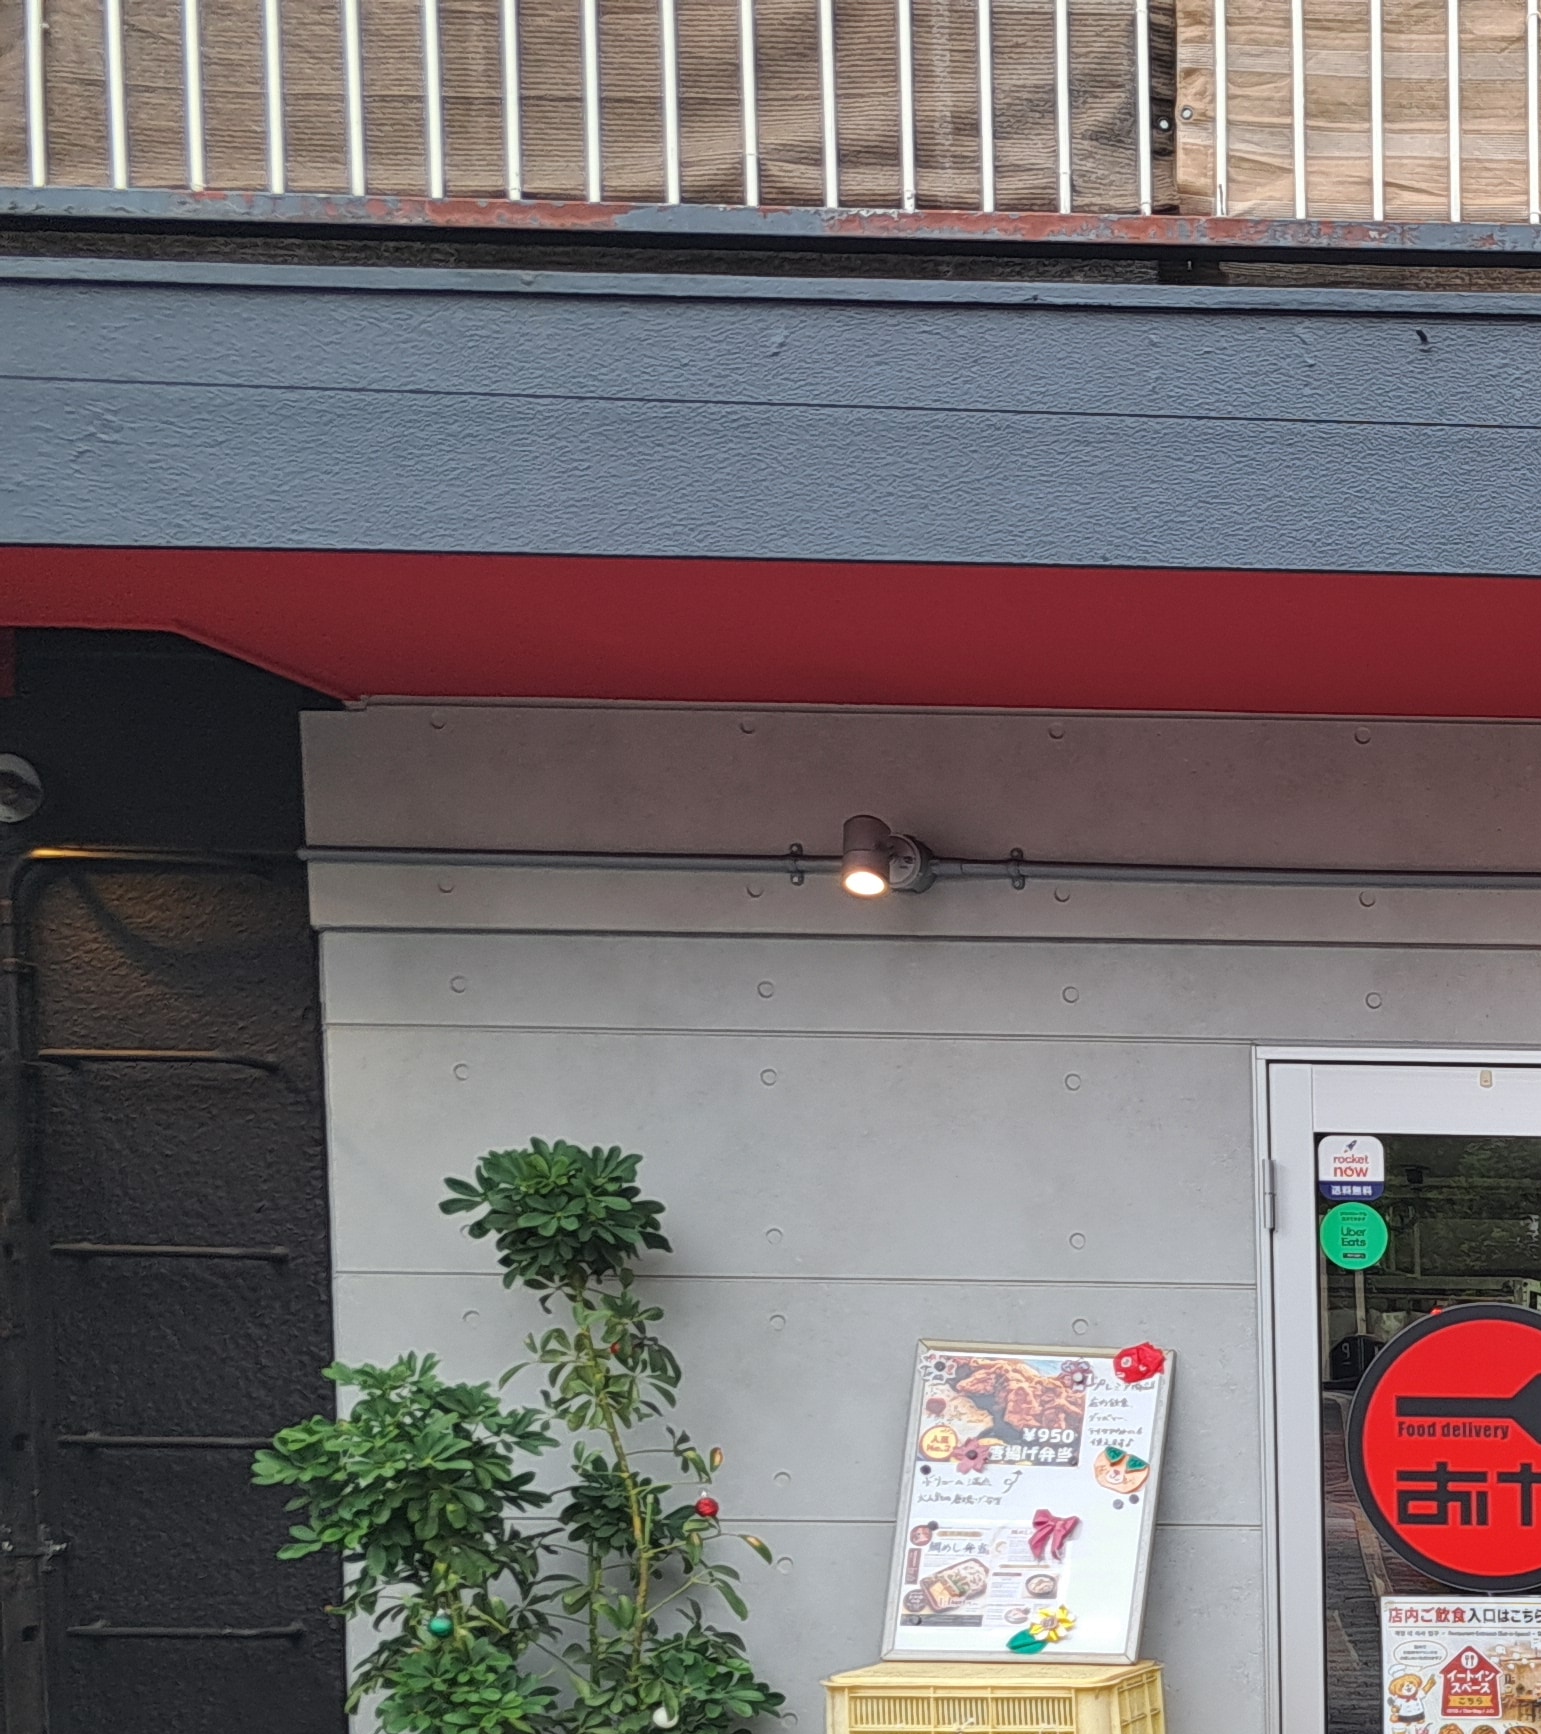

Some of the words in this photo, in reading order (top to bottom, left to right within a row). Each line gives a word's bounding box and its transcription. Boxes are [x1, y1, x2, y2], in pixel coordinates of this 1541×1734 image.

[1333, 1154, 1369, 1164] rocket
[1333, 1167, 1369, 1177] now
[1341, 1227, 1366, 1236] Uber
[1341, 1238, 1366, 1247] Eats
[1022, 1428, 1076, 1443] ¥950
[1398, 1422, 1437, 1437] Food
[1441, 1422, 1509, 1440] delivery
[1446, 1669, 1496, 1682] イートイン
[1458, 1697, 1484, 1706] こちら
